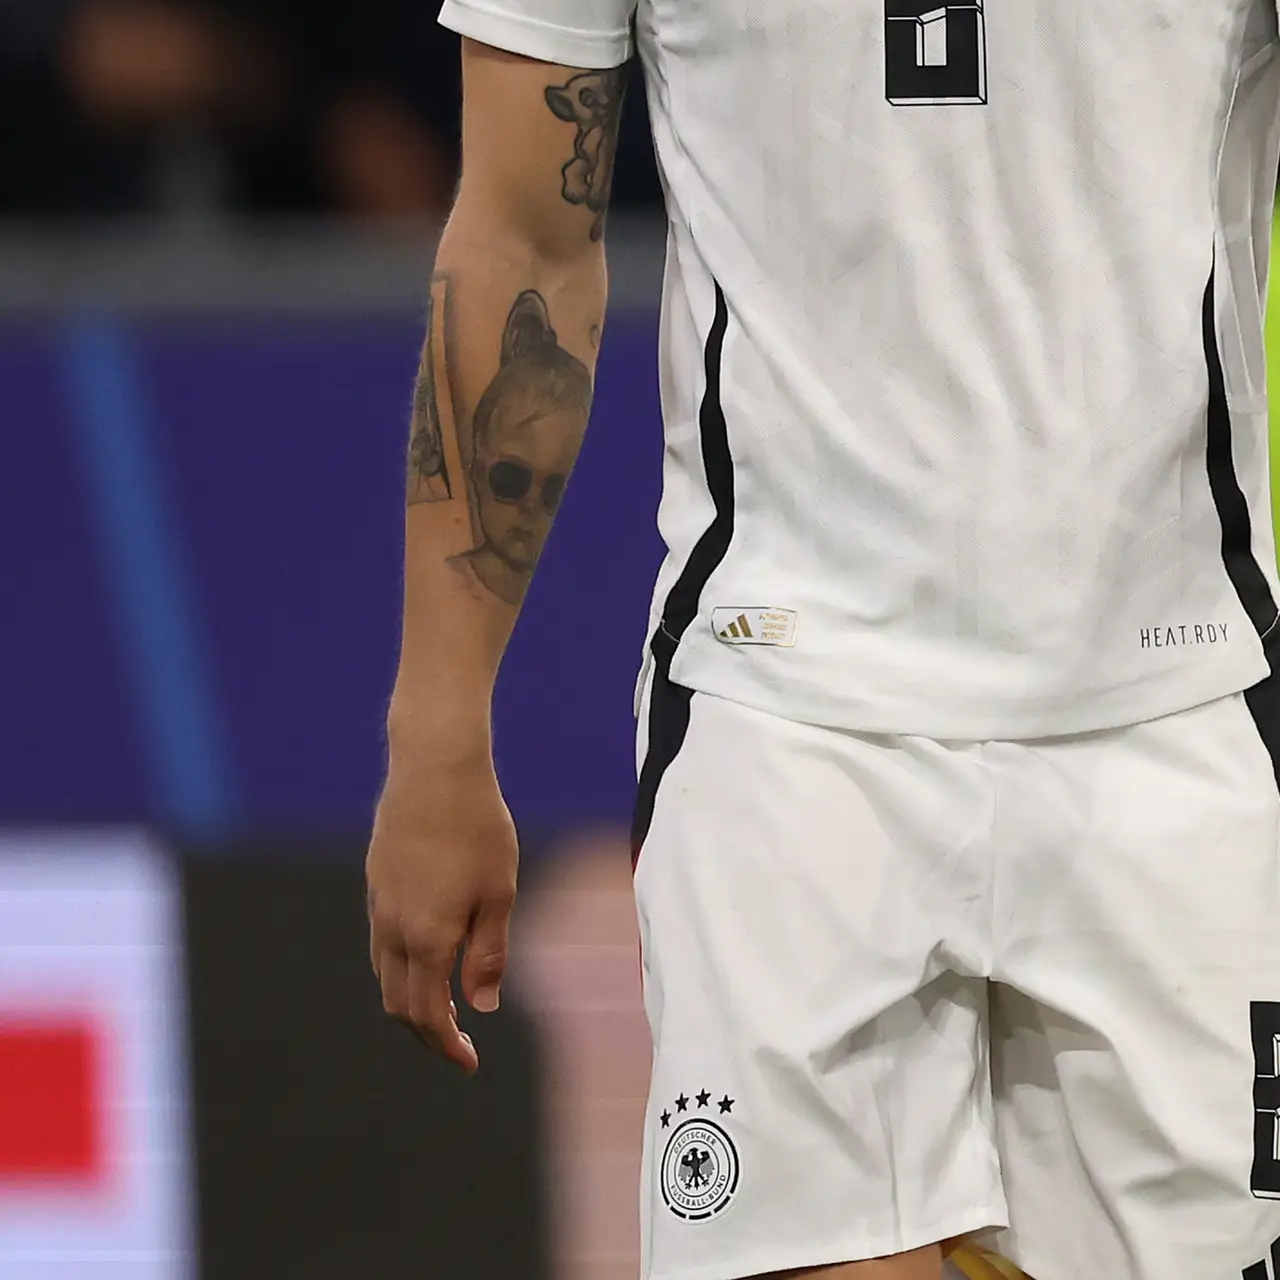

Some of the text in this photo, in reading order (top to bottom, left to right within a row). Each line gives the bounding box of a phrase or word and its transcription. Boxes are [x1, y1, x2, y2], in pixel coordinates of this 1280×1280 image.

[1140, 623, 1228, 648] HEAT.RDY
[673, 1131, 717, 1154] DEUTSCHER
[670, 1174, 727, 1207] FUSSBALL-BUND
